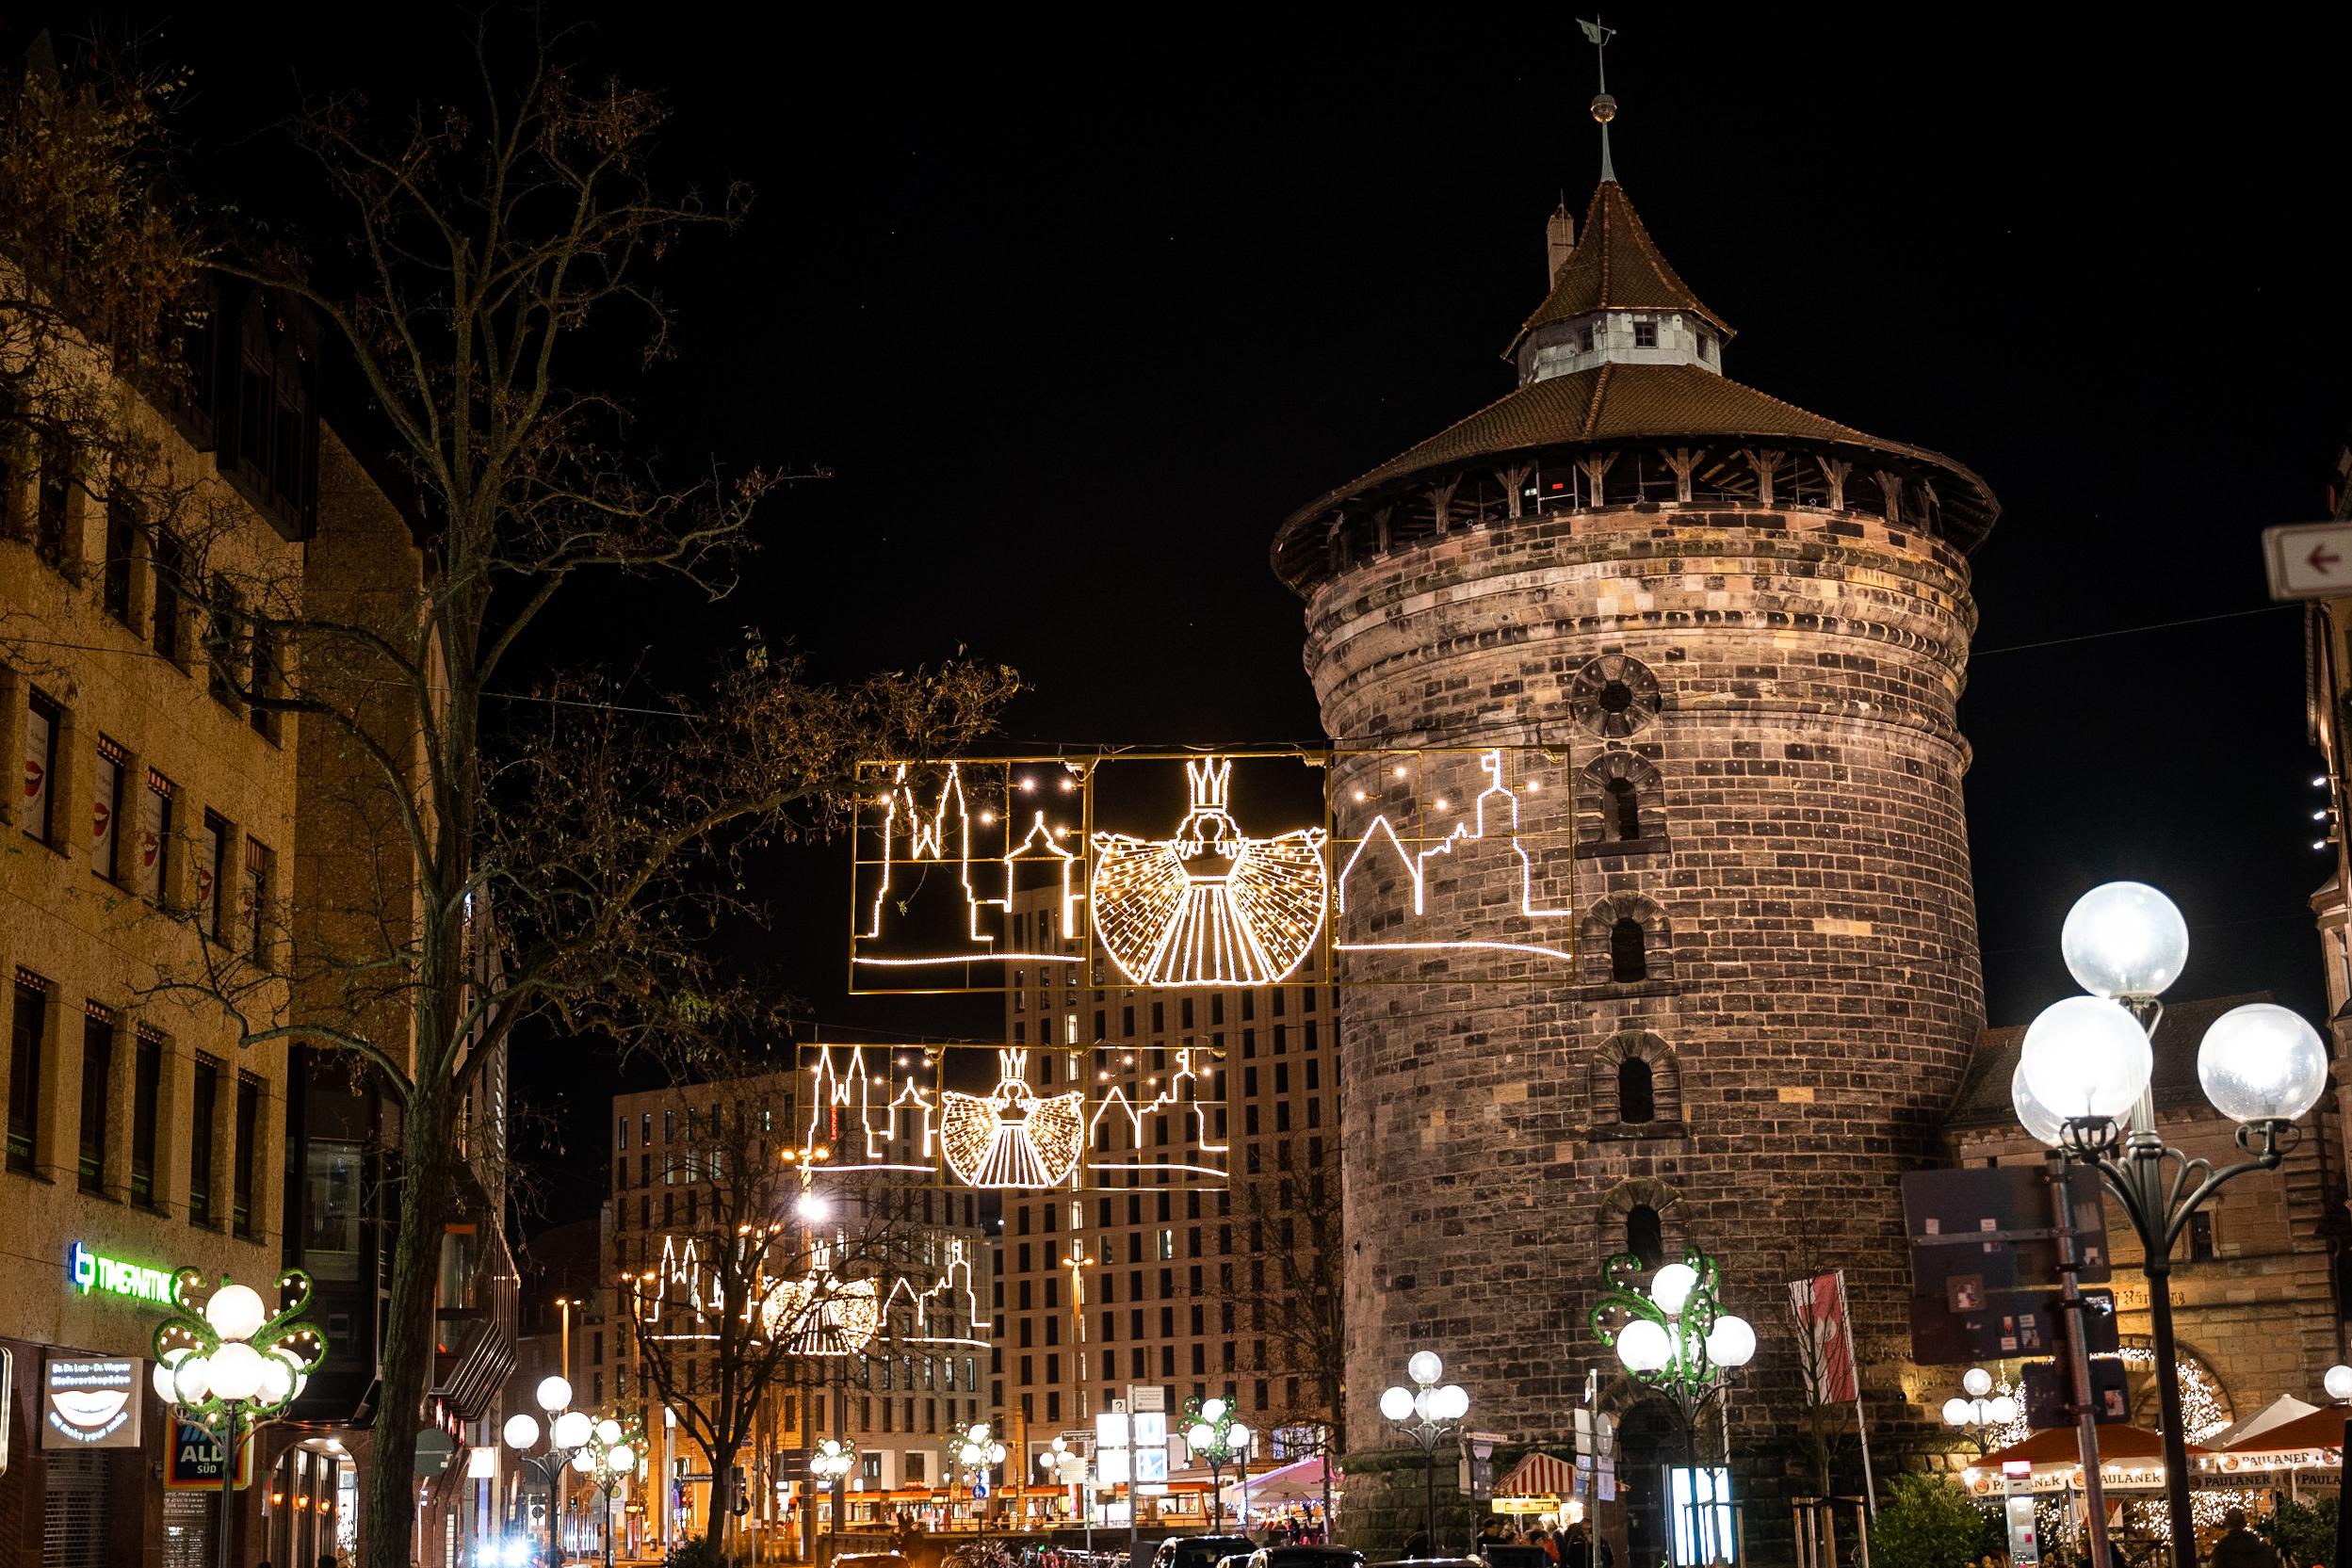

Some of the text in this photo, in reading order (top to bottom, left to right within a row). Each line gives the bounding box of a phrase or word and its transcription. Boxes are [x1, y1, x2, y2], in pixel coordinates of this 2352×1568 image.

[181, 1445, 223, 1462] ALD
[2243, 1452, 2311, 1466] PAULANER
[197, 1463, 217, 1474] SÜD
[1993, 1478, 2061, 1491] PANER
[2101, 1473, 2162, 1484] AULANER
[2205, 1474, 2271, 1487] PAULANER
[2301, 1474, 2342, 1485] PAULA
